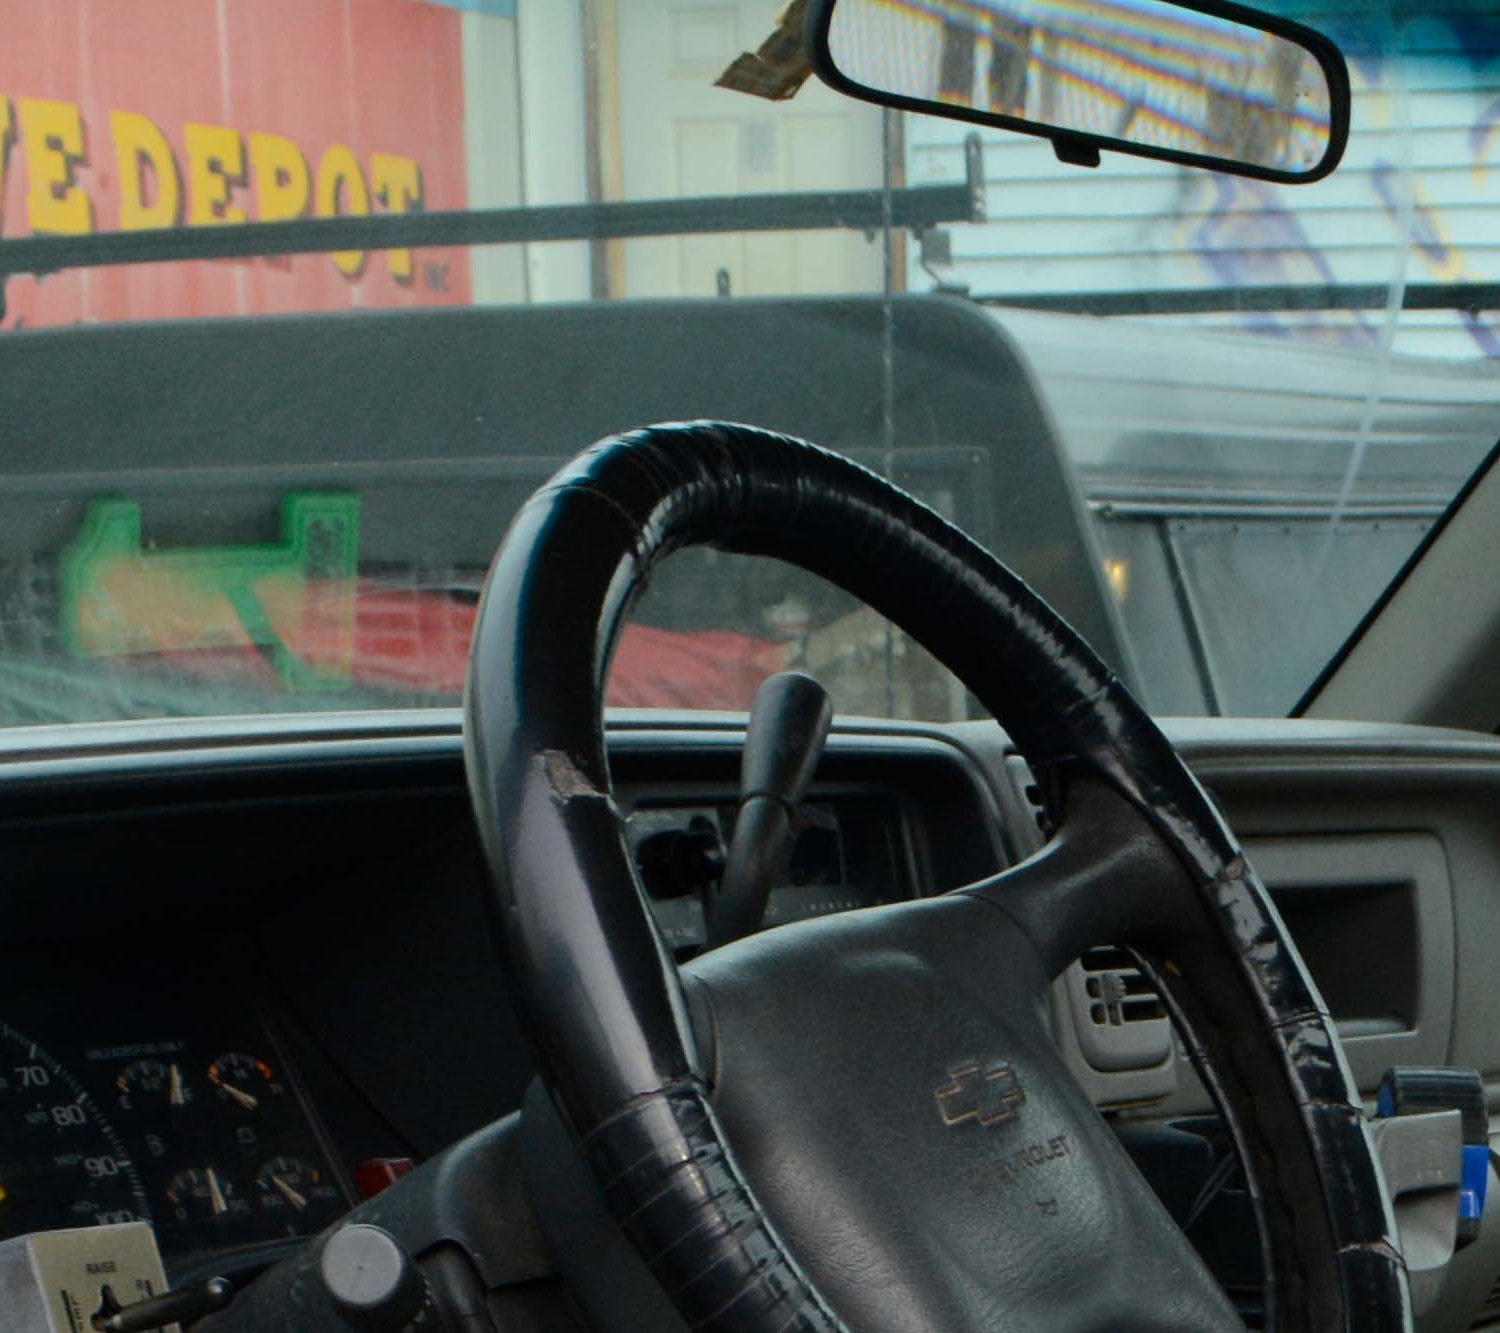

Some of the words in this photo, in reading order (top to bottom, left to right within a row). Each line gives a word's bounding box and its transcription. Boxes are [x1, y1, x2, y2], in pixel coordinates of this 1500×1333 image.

[109, 110, 422, 285] DEPOT
[13, 1065, 50, 1088] 70
[51, 1104, 87, 1127] 80
[84, 1155, 119, 1178] 90
[95, 1210, 134, 1226] 100
[85, 1261, 118, 1275] RAISE
